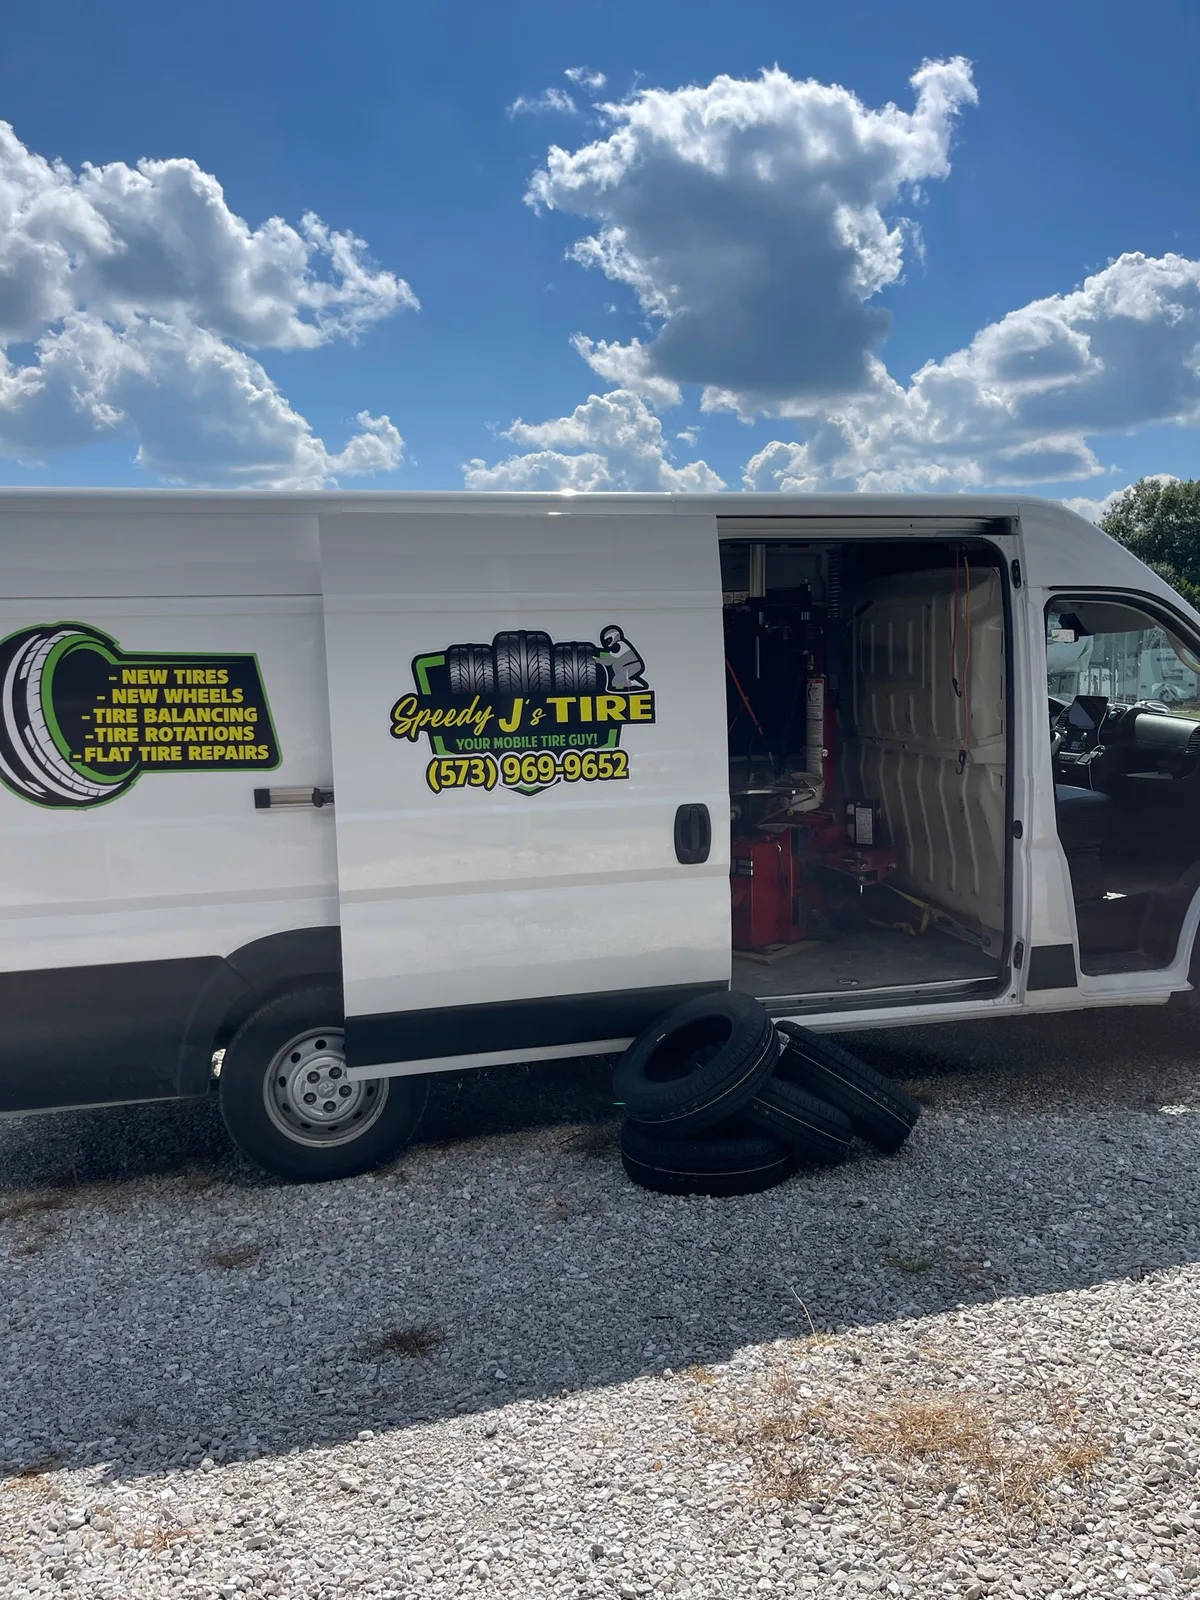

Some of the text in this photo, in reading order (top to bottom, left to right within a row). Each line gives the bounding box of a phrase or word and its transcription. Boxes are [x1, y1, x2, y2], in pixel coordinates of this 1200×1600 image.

[174, 669, 229, 685] TIRES
[164, 688, 244, 704] WHEELS
[144, 707, 258, 724] BALANCING
[394, 695, 495, 738] Speedy
[546, 694, 653, 723] TIRE
[145, 726, 255, 743] ROTATIONS
[456, 733, 598, 751] YOUR MOBILE TIRE GUY!
[138, 746, 182, 761] TIRE
[188, 745, 269, 761] REPAIRS
[429, 752, 628, 794] (573) 969-9652
